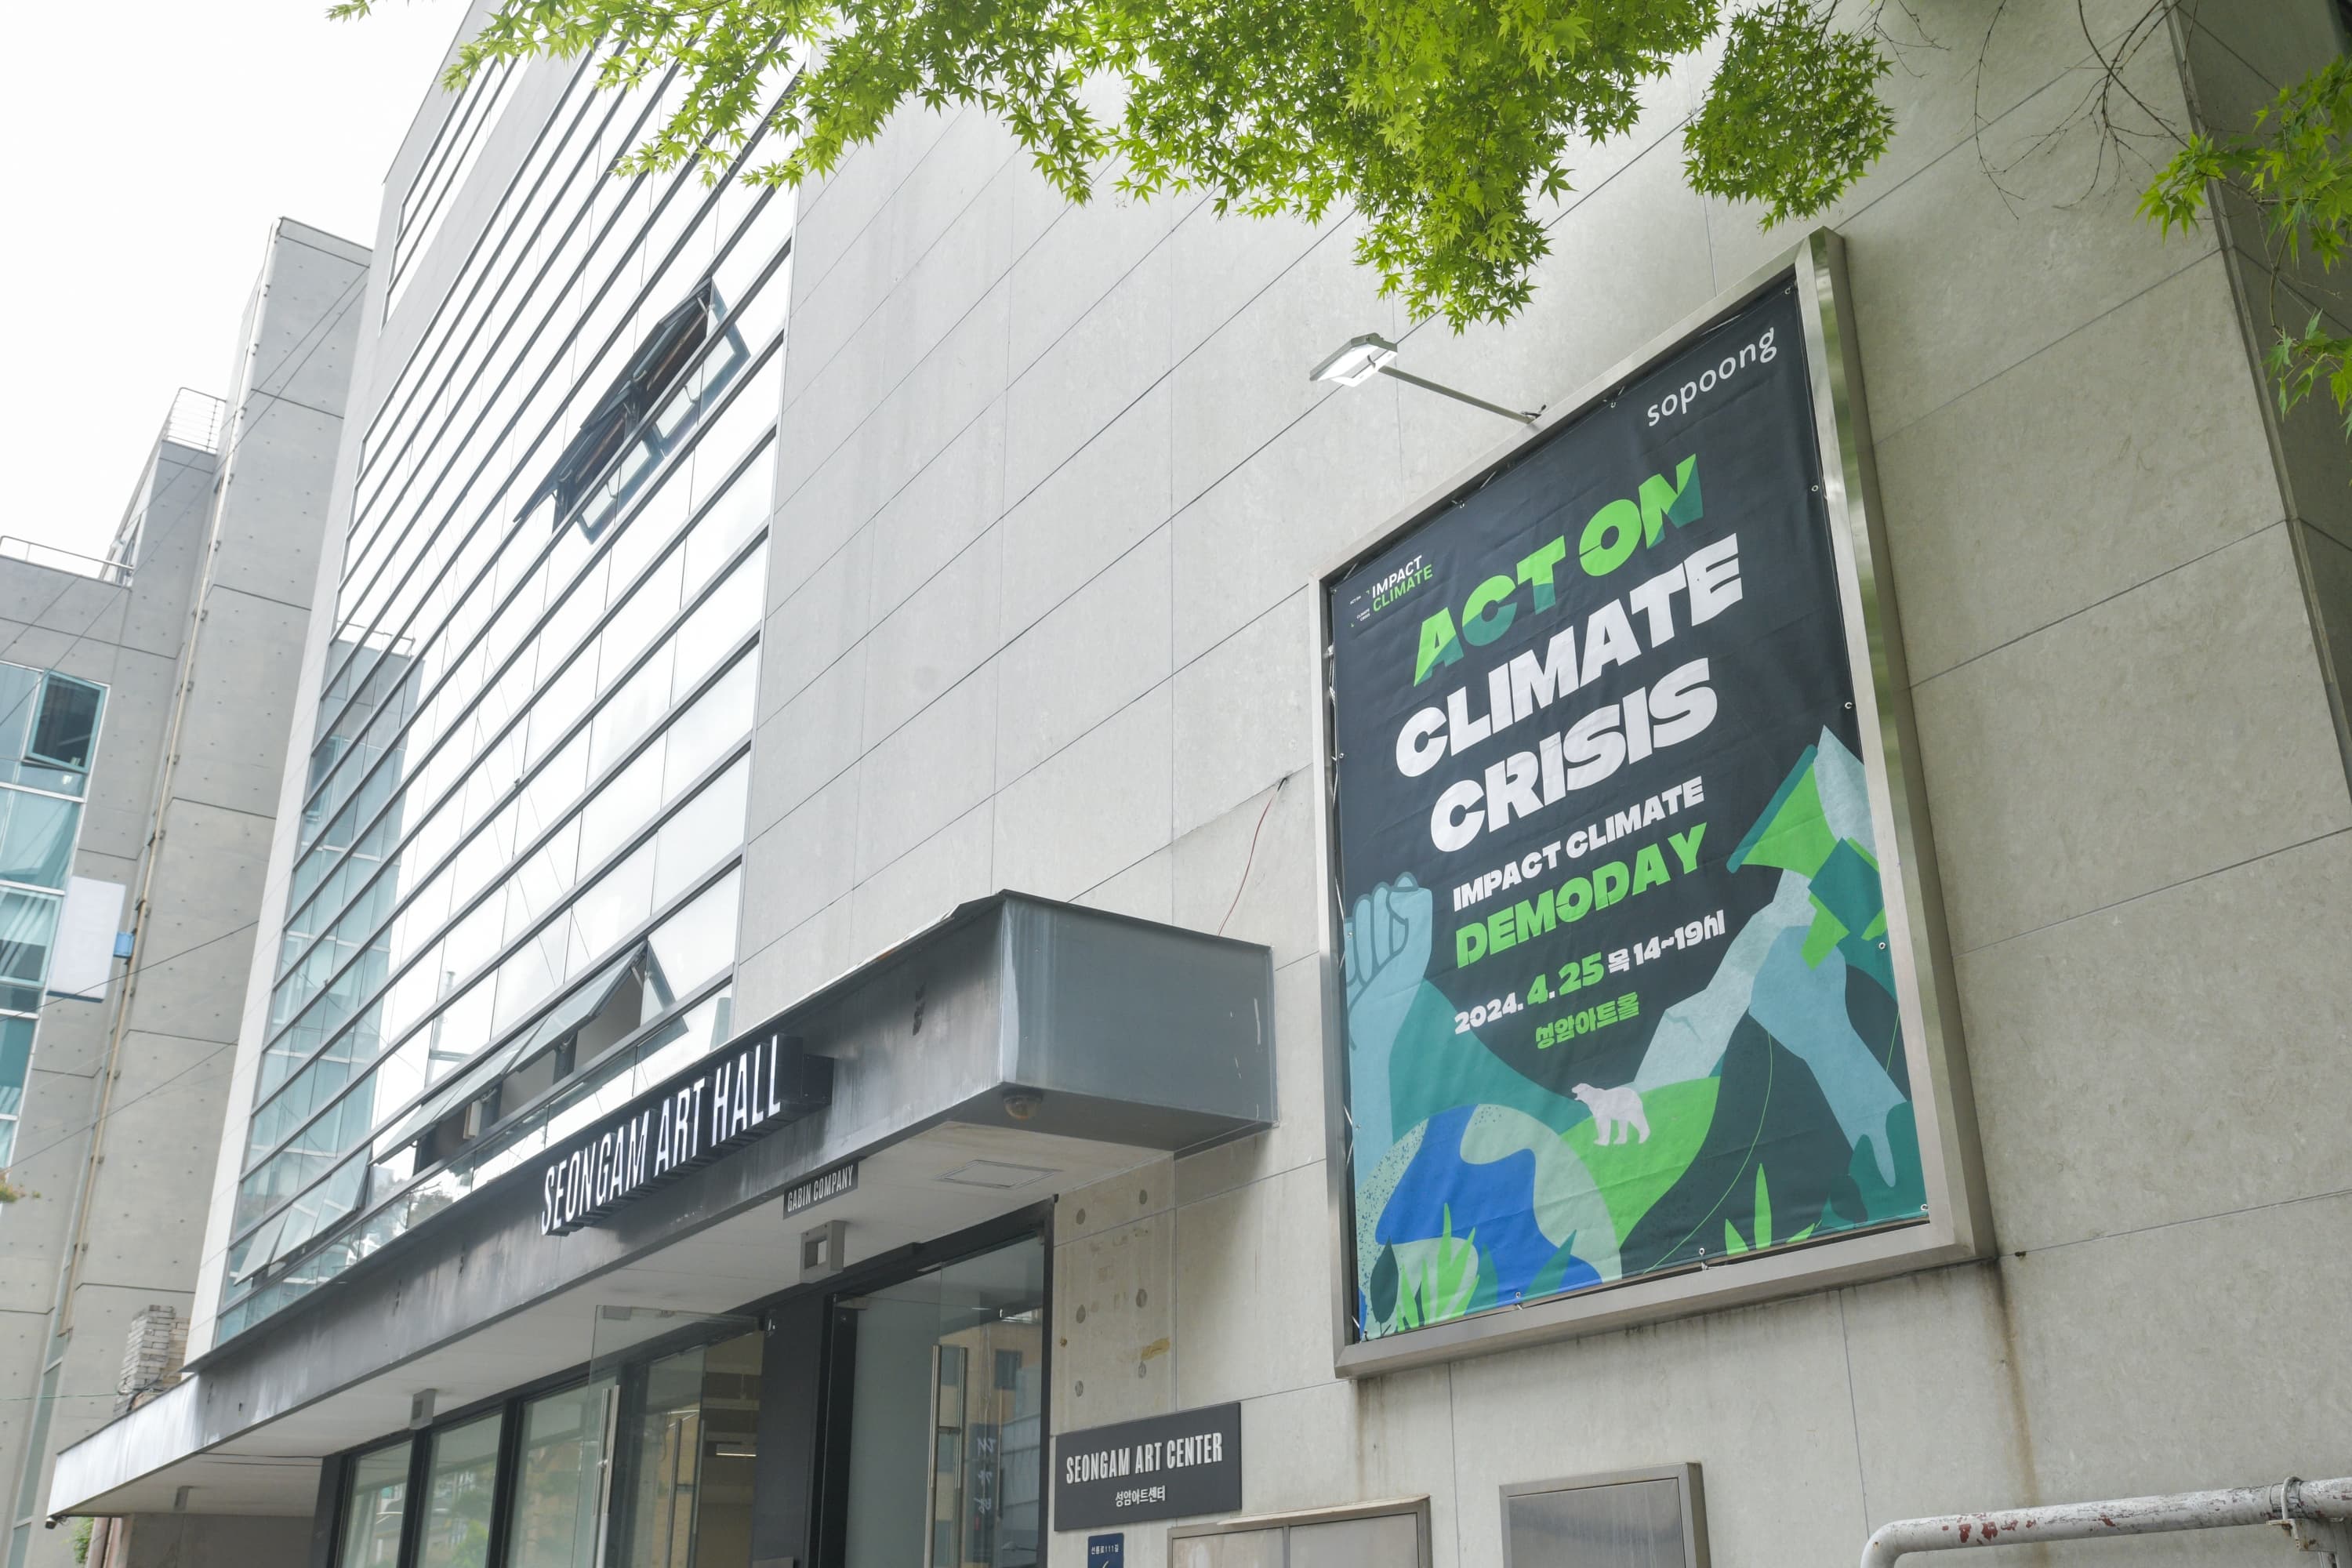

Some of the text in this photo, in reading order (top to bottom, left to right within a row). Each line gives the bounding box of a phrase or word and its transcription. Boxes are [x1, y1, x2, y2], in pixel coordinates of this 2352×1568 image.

[1647, 327, 1777, 426] sopoong
[1372, 555, 1422, 598] IMPACT
[1373, 564, 1433, 612] CLIMATE
[1414, 453, 1704, 688] ACT ON
[1396, 533, 1743, 777] CLIMATE
[1430, 658, 1719, 852] CRISIS
[1453, 776, 1705, 911] IMPACT CLIMATE
[1456, 822, 1708, 968] DEMODAY
[1535, 991, 1639, 1050] 성암아트홀
[541, 1034, 782, 1236] SEONGAM ART HALL
[788, 1164, 853, 1212] GABIN COMPANY
[1066, 1432, 1223, 1484] SEONGAM ART CENTER
[1115, 1485, 1166, 1508] 성암아트센터
